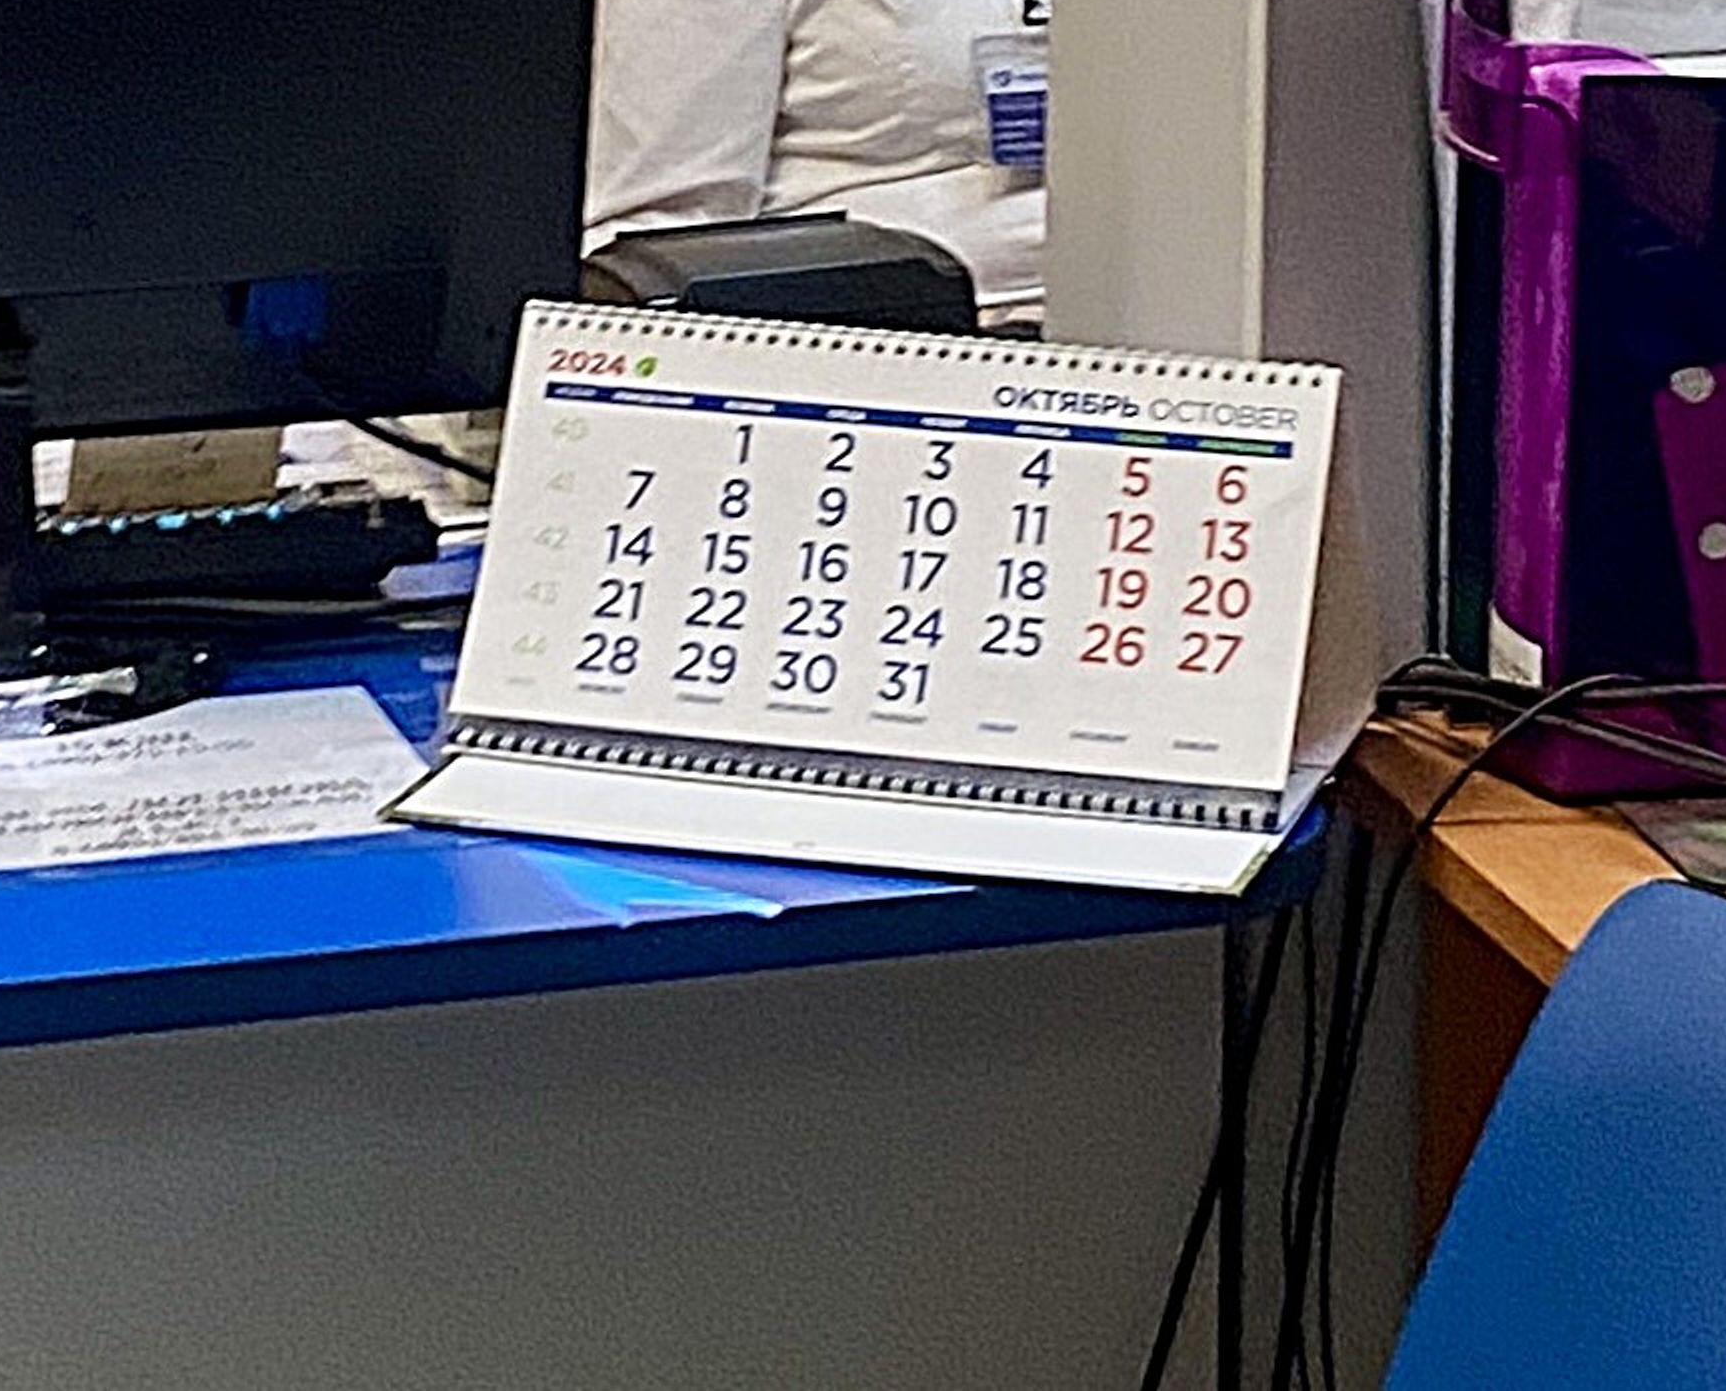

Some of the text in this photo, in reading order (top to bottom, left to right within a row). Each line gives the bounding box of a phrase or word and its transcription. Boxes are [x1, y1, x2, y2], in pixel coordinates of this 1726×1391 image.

[546, 348, 628, 378] 2024
[993, 385, 1299, 430] ОКТЯБРЬ OCTOBER
[736, 423, 754, 465] 1
[824, 432, 857, 473] 2
[924, 440, 955, 481] 3
[1020, 448, 1053, 489] 4
[1121, 456, 1152, 497] 5
[1216, 464, 1248, 505] 6
[625, 468, 657, 510] 7
[719, 477, 751, 519] 8
[815, 486, 848, 527] 9
[903, 494, 958, 537] 10
[1012, 503, 1049, 545] 11
[1106, 511, 1154, 553] 12
[1202, 519, 1252, 562] 13
[605, 523, 655, 567] 14
[704, 532, 751, 574] 15
[799, 540, 850, 583] 16
[900, 549, 948, 592] 17
[997, 558, 1048, 601] 18
[1096, 566, 1149, 609] 19
[1182, 574, 1252, 619] 20
[593, 578, 645, 621] 21
[684, 587, 748, 630] 22
[781, 595, 848, 639] 23
[879, 605, 945, 648] 24
[980, 614, 1045, 657] 25
[1079, 622, 1147, 667] 26
[1177, 631, 1245, 674] 27
[574, 632, 640, 676] 28
[671, 641, 739, 685] 29
[770, 650, 838, 695] 30
[877, 660, 929, 705] 31
